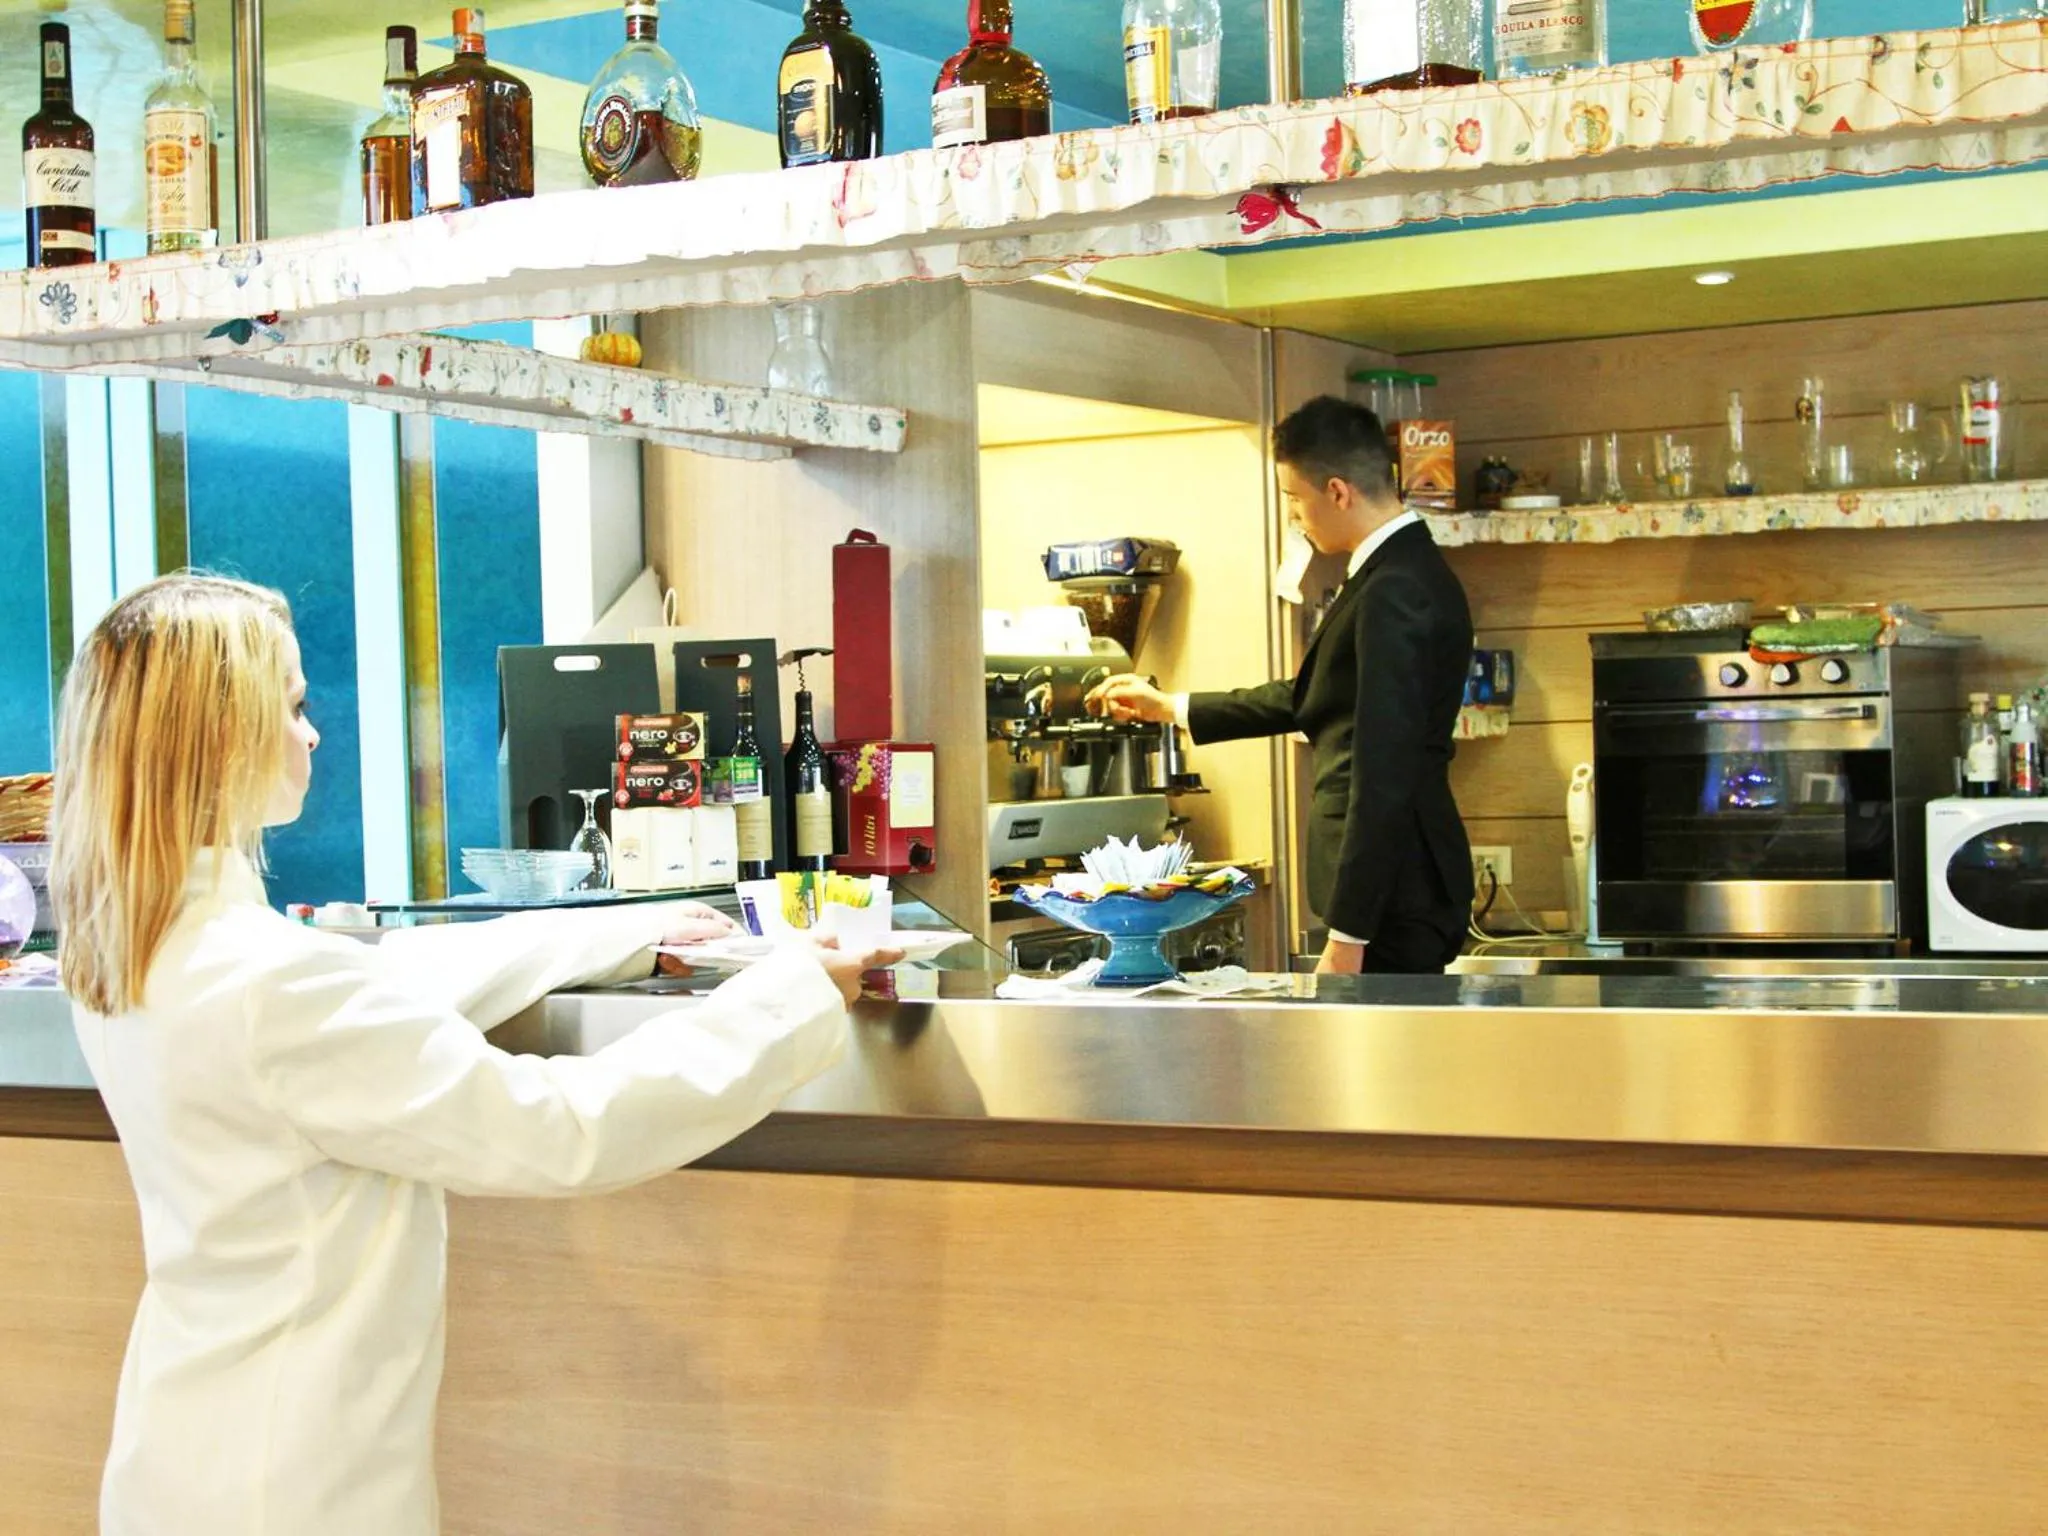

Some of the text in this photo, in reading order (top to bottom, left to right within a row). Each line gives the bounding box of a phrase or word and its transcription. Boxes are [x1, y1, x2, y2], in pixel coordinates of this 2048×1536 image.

[1538, 15, 1585, 29] BLANCO
[36, 159, 91, 179] Canadian
[1405, 425, 1450, 447] Orzo
[629, 729, 668, 741] nero
[625, 776, 664, 788] nero
[863, 814, 877, 857] 10 litri
